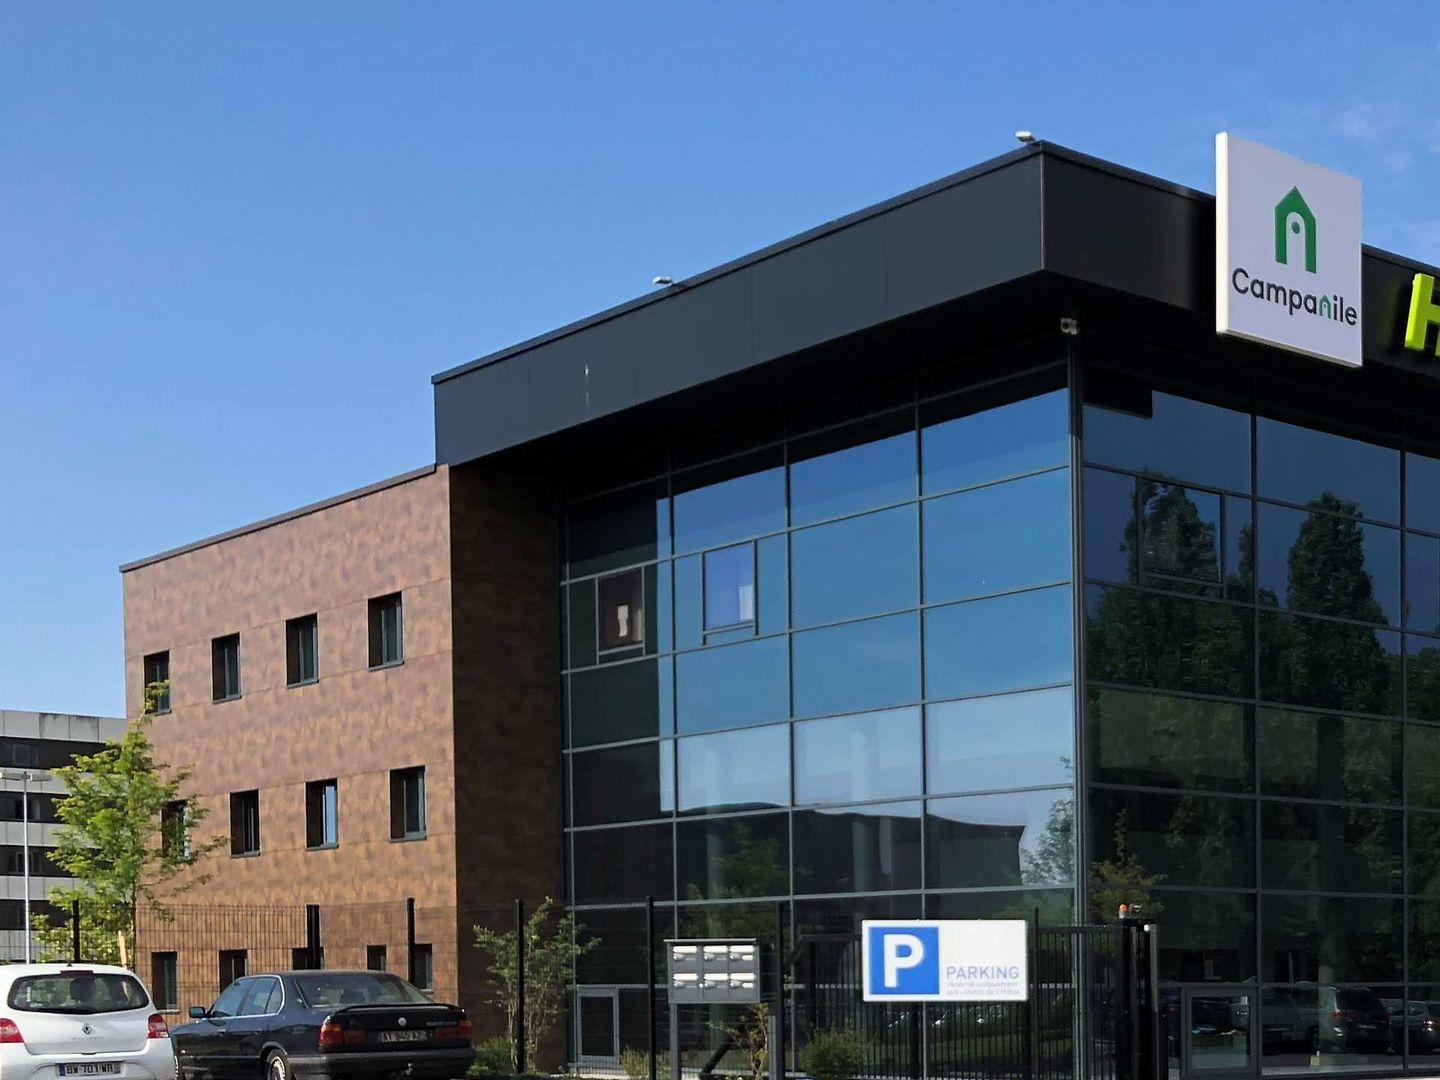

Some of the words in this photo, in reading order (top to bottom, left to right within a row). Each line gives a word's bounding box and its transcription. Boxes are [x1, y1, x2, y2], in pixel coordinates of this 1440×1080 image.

[1231, 268, 1358, 327] Campanile
[883, 933, 924, 988] P
[946, 965, 1020, 979] PARKING
